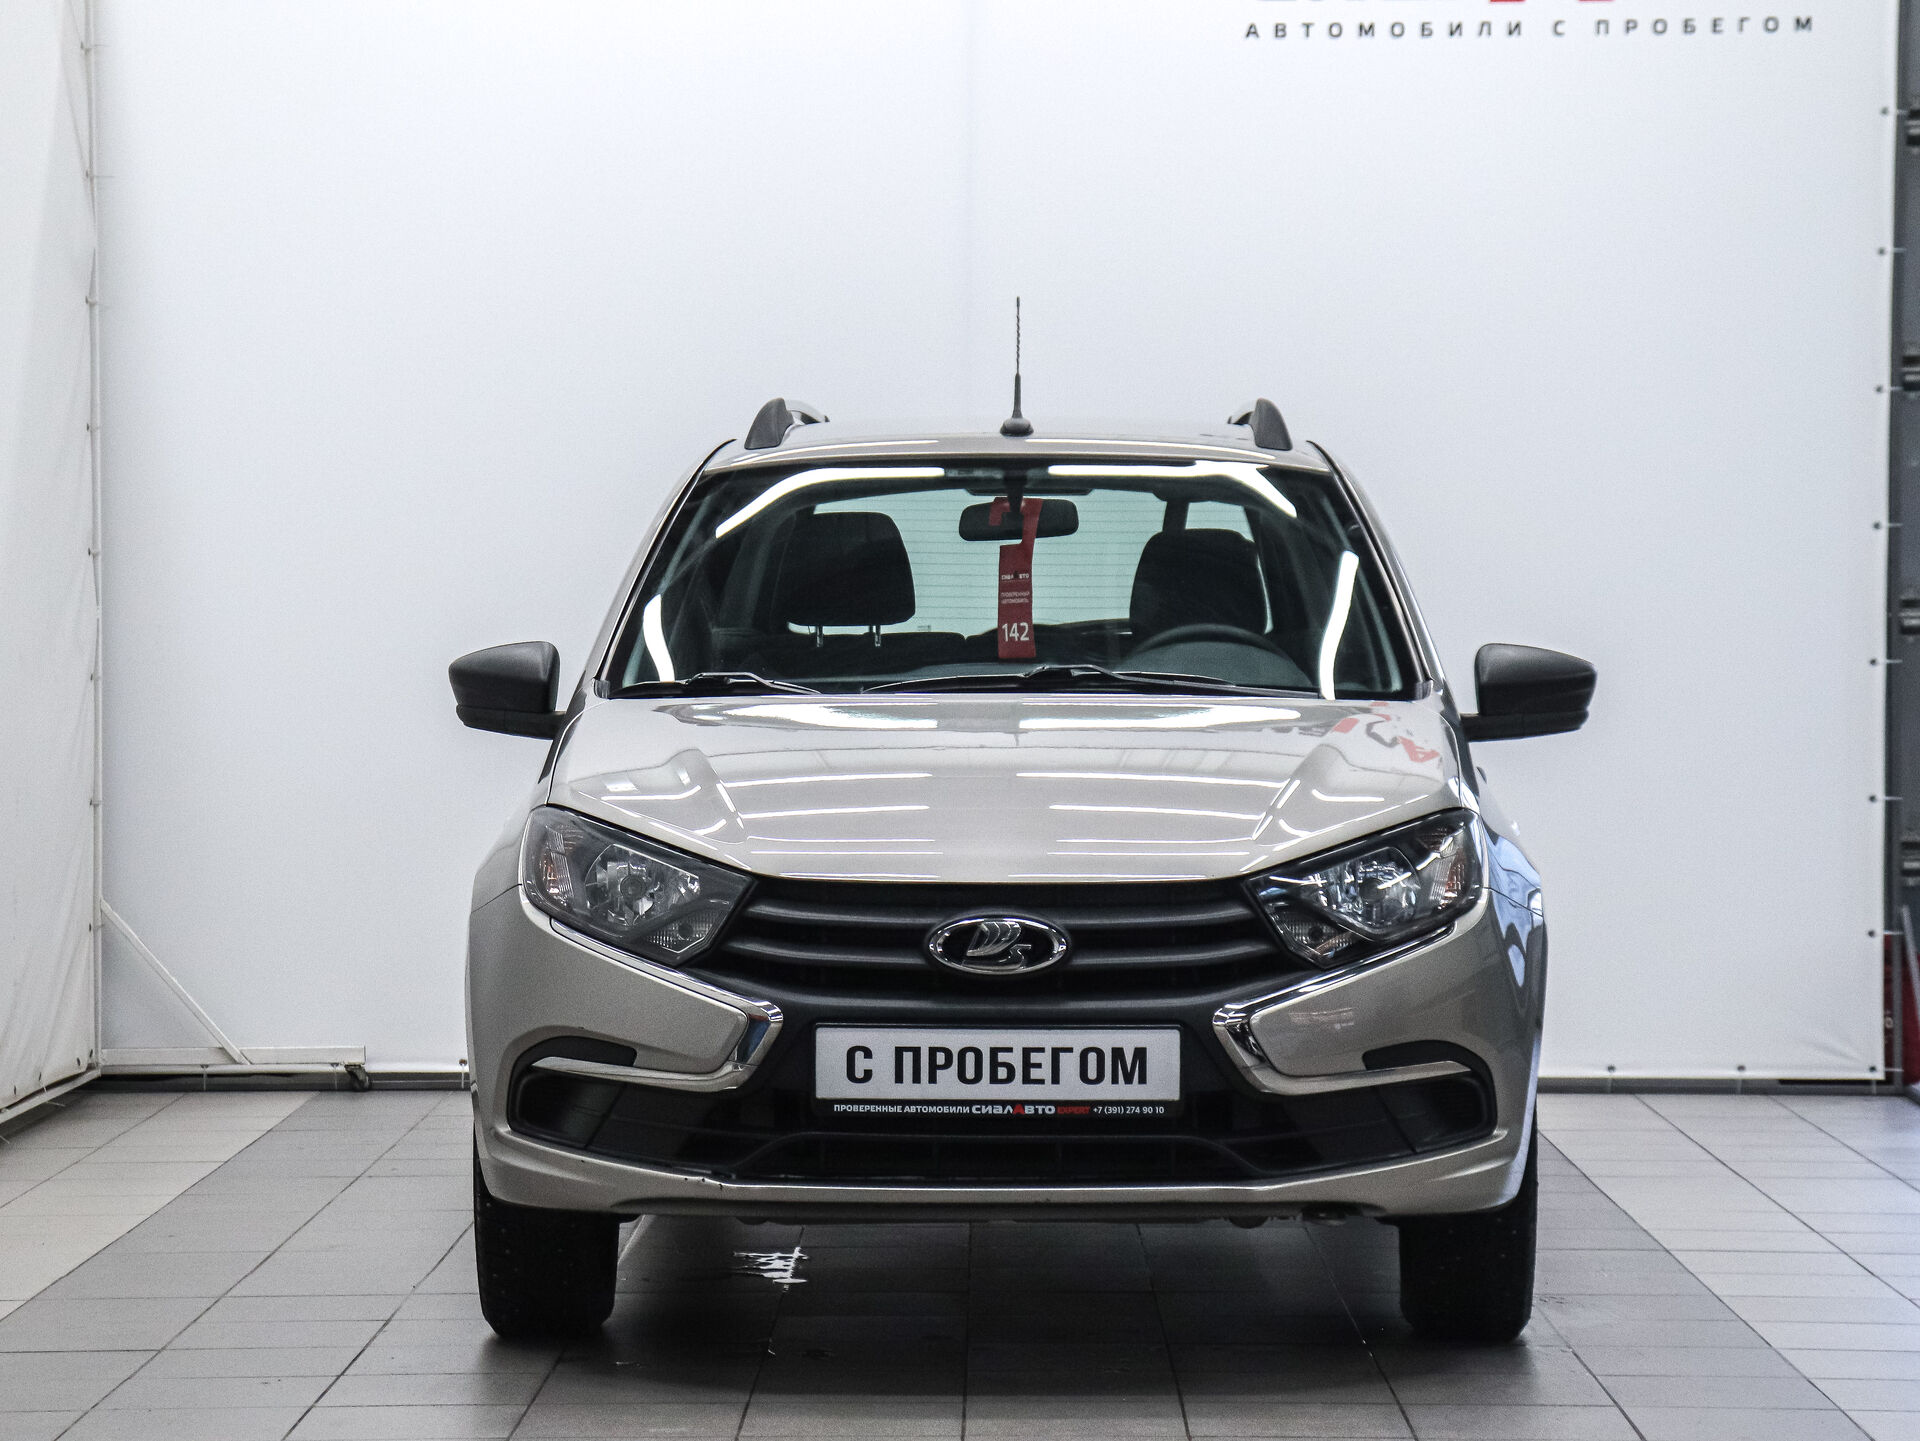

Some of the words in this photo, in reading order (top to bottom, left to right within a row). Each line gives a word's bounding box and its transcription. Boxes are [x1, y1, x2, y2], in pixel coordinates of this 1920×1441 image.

[1245, 21, 1522, 38] АВТОМОБИЛИ
[1552, 20, 1566, 36] С
[1595, 16, 1813, 35] ПРОБЕГОМ
[1001, 621, 1030, 642] 142
[846, 1045, 873, 1084] С
[894, 1046, 1148, 1085] ПРОБЕГОМ
[833, 1104, 903, 1113] ПРОВЕРЕННЫЕ
[903, 1105, 970, 1114] АВТОМОБИЛИ
[1092, 1106, 1102, 1114] +7
[1104, 1106, 1124, 1115] (391)
[1126, 1106, 1140, 1114] 274
[1142, 1106, 1153, 1114] 90
[1155, 1106, 1165, 1114] 10
